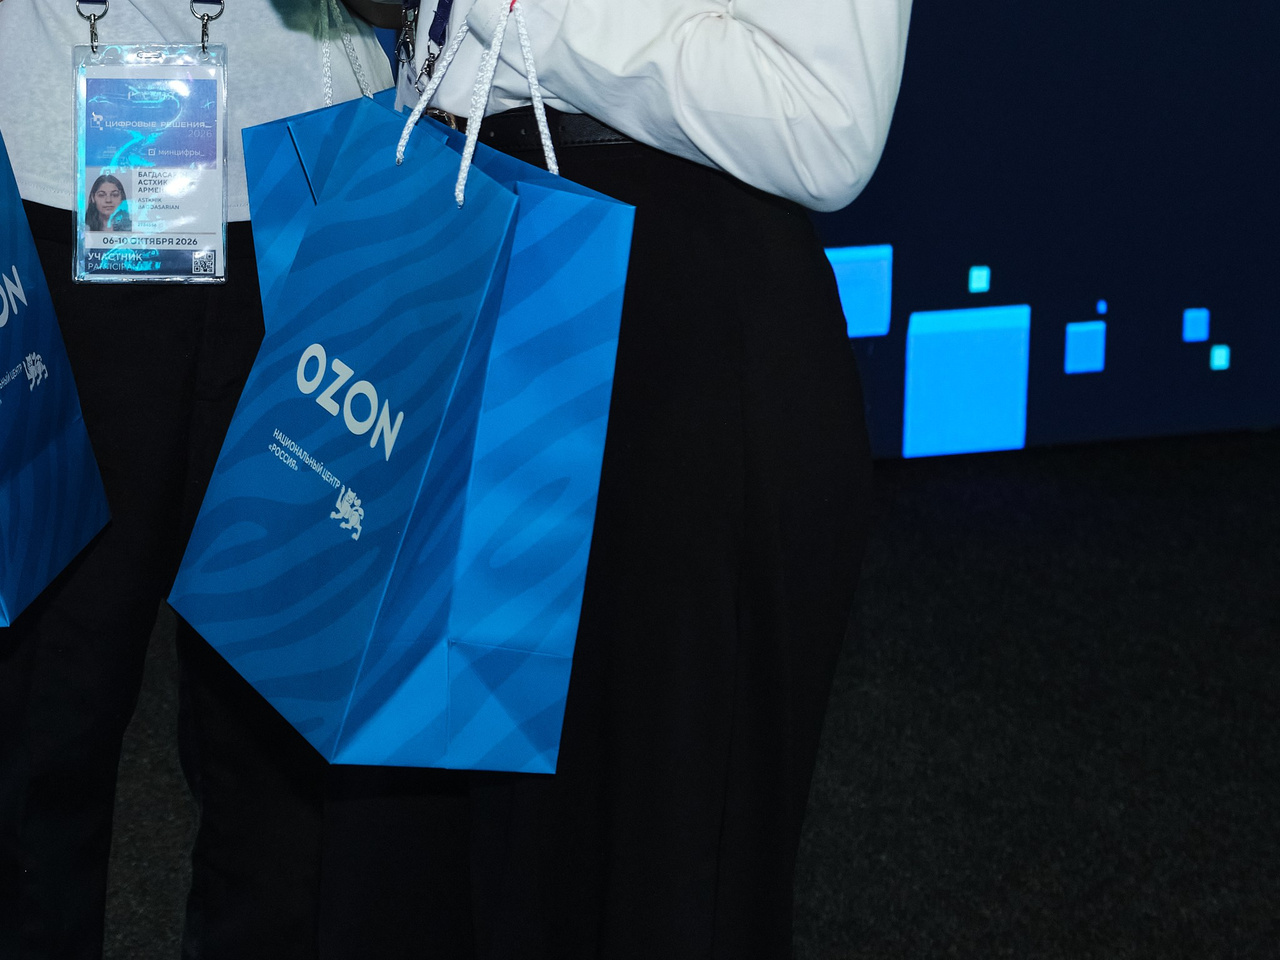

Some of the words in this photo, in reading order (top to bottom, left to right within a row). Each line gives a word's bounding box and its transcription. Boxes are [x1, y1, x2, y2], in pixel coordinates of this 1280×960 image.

[188, 129, 213, 138] 2026
[102, 237, 129, 245] 06-10
[130, 237, 174, 245] ОКТЯБРЯ
[175, 237, 198, 245] 2026
[88, 252, 143, 261] УЧАСТНИК
[296, 343, 404, 462] OZON
[268, 443, 299, 472] «РОССИЯ»
[272, 428, 324, 478] НАЦИОНАЛЬНЫЙ
[321, 467, 341, 489] ЦЕНТР
